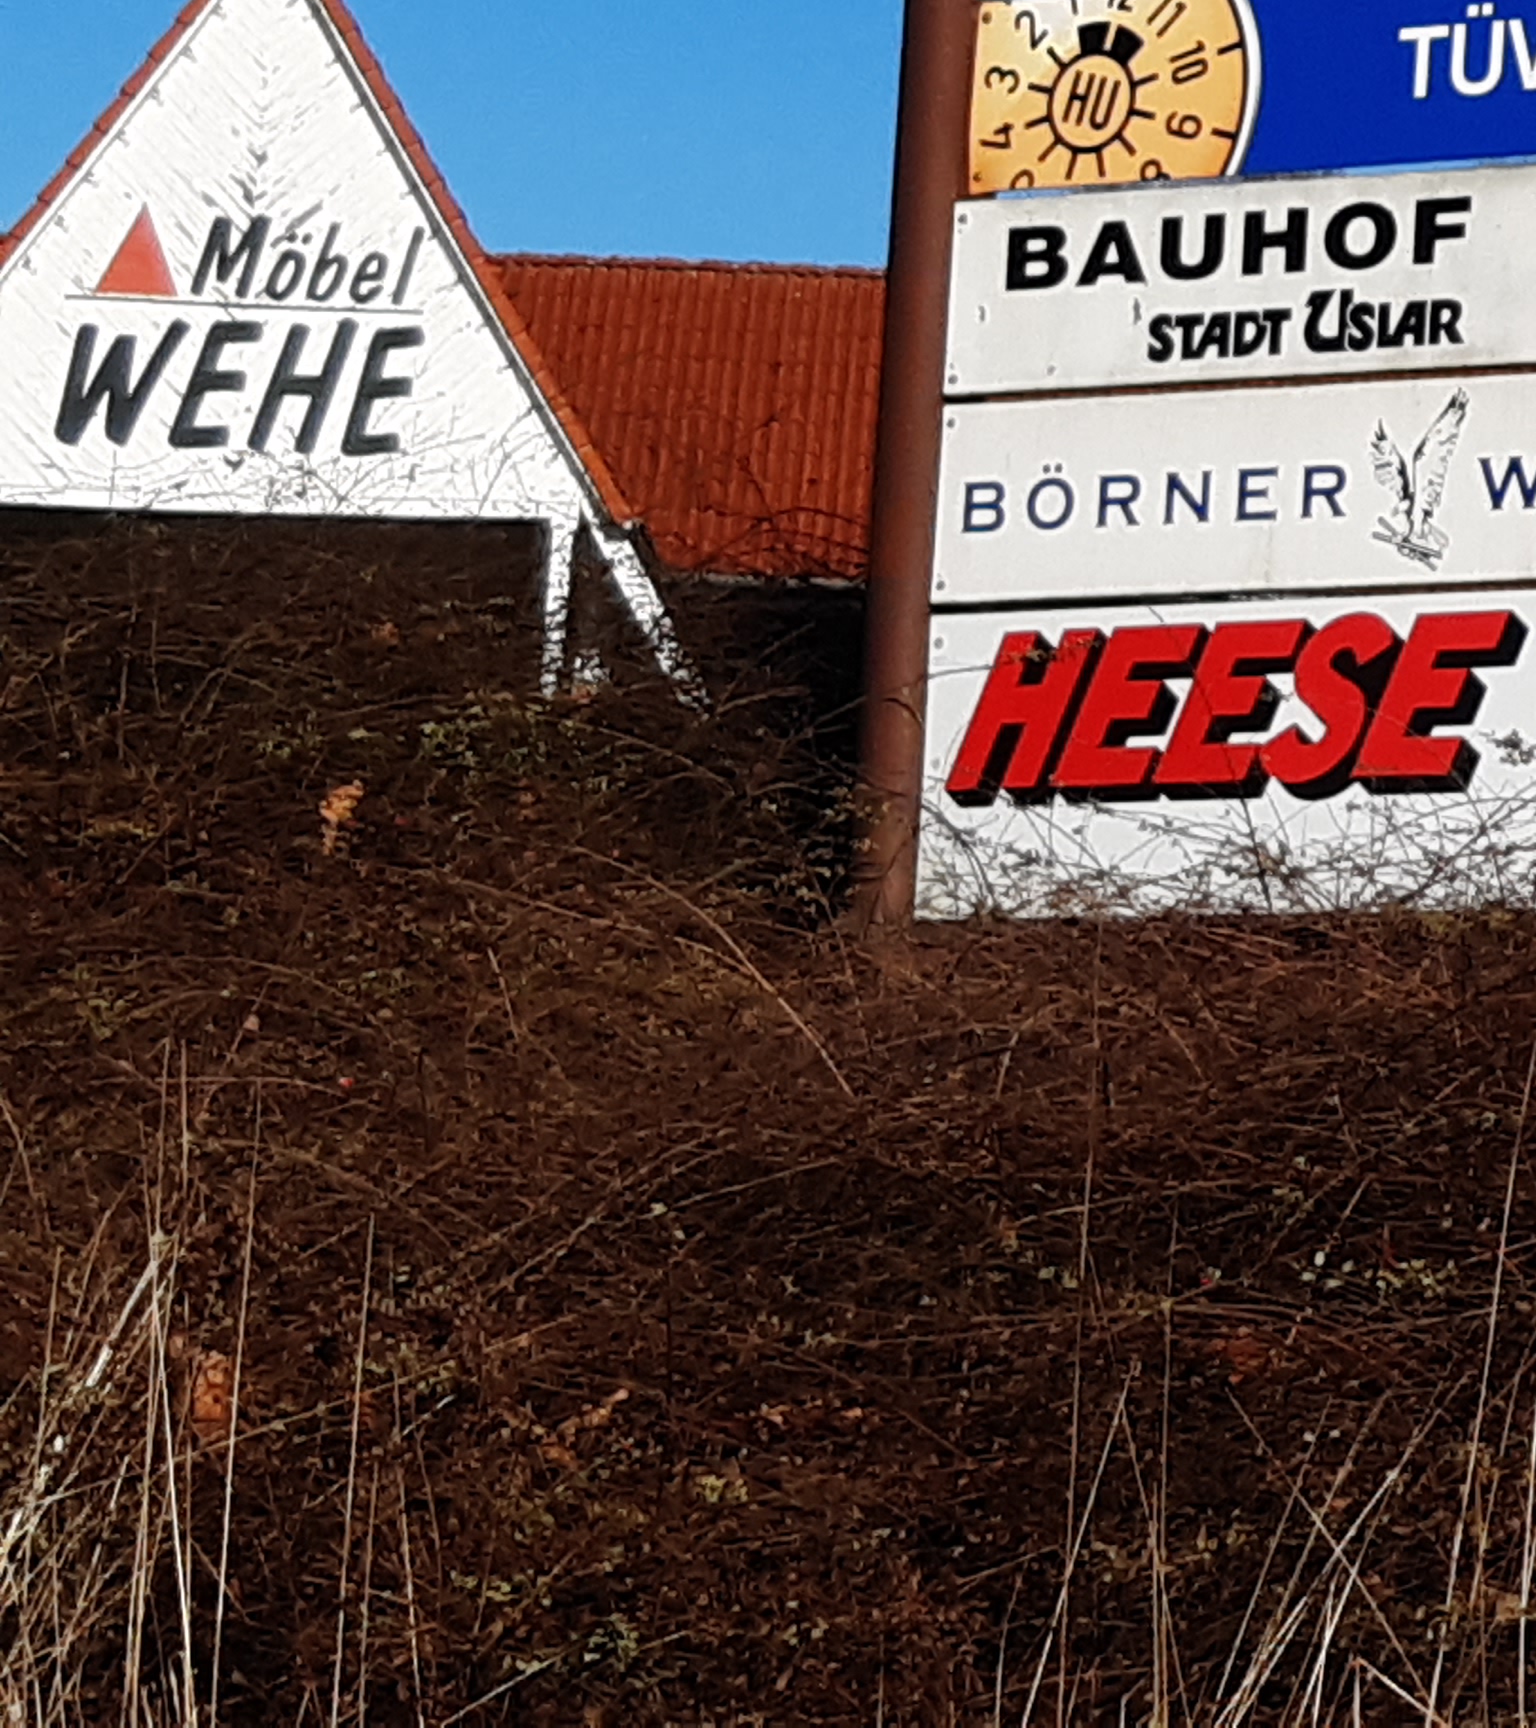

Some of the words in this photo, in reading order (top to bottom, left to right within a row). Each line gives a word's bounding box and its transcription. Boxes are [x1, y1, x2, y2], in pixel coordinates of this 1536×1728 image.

[1014, 10, 1048, 50] 2
[984, 66, 1020, 94] 3
[1168, 40, 1209, 85] 10
[1062, 70, 1121, 131] HU
[979, 123, 1014, 149] 4
[191, 215, 424, 305] Möbel
[1004, 195, 1472, 294] BAUHOF
[1147, 308, 1291, 363] STADT
[54, 318, 425, 456] WEHE
[961, 462, 1347, 533] BÖRNER
[945, 608, 1530, 807] HEESE
